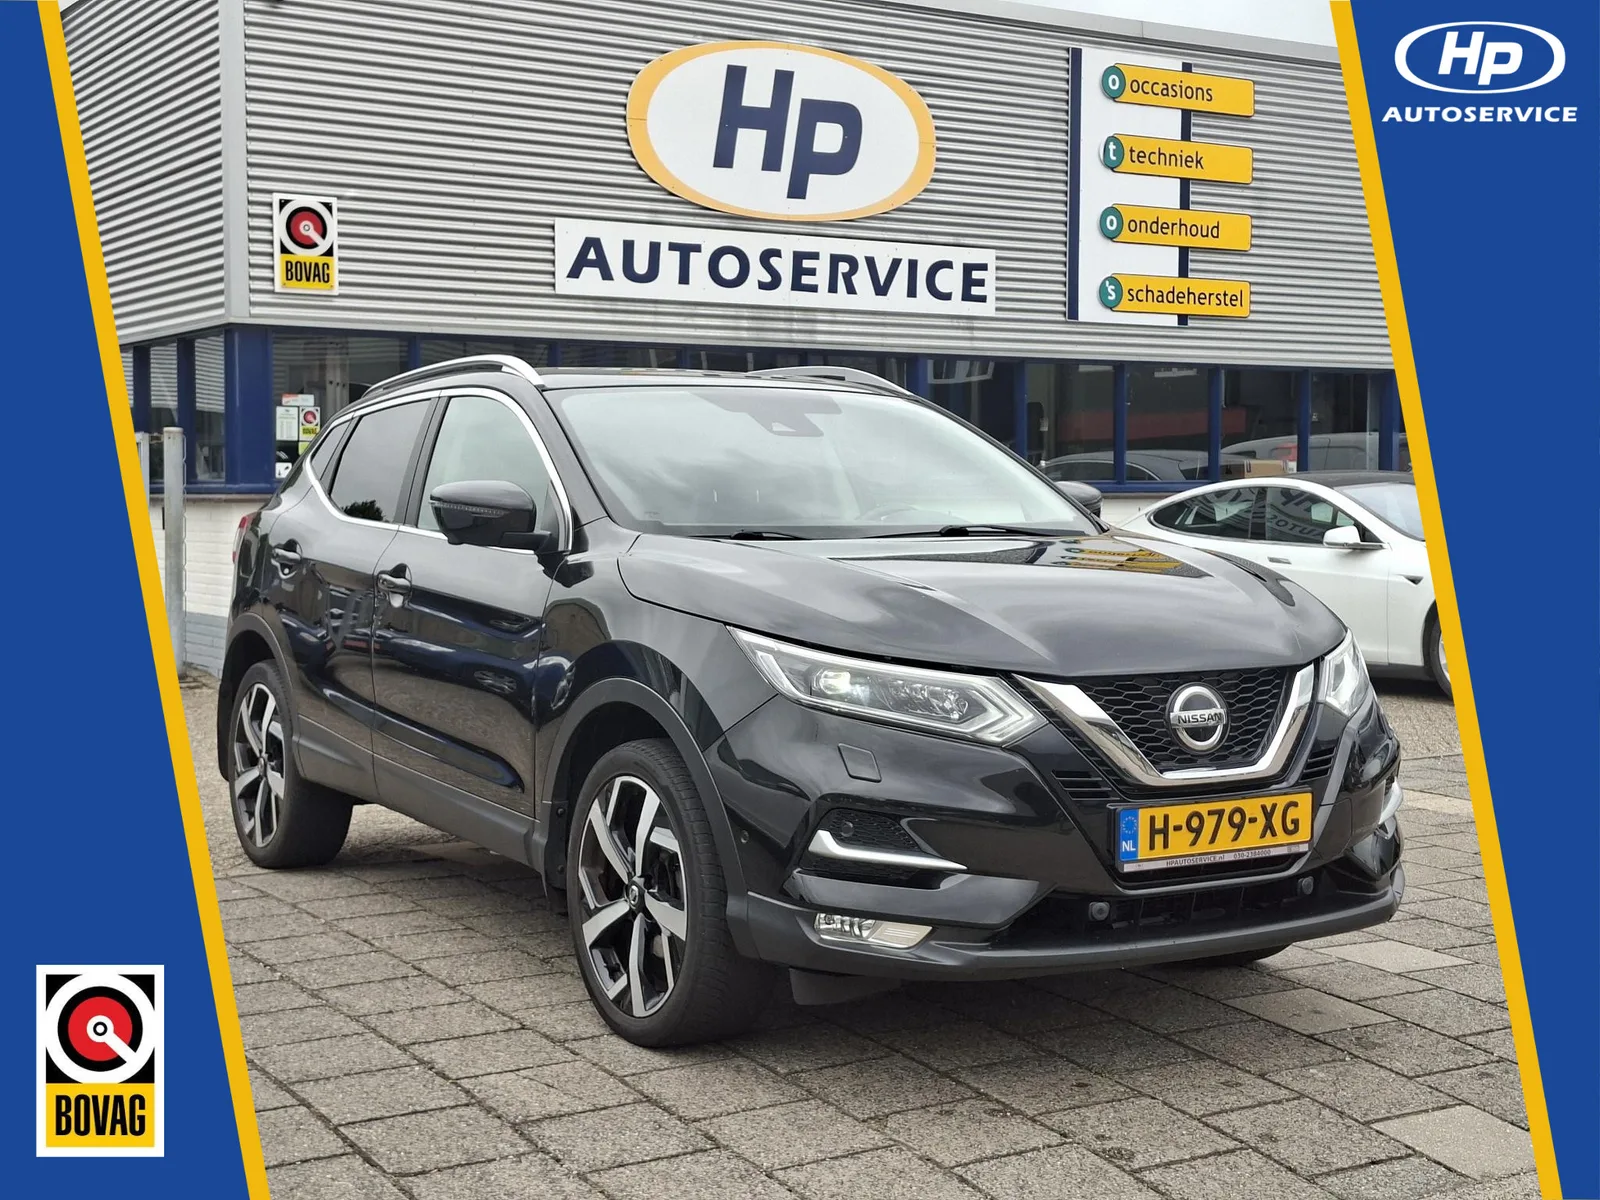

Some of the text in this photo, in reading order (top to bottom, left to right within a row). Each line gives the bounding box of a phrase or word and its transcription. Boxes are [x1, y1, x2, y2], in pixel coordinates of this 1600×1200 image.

[1130, 79, 1213, 102] occasions
[1129, 146, 1204, 170] techniek
[1128, 216, 1220, 239] onderhoud
[285, 260, 330, 283] BOVAG
[566, 236, 989, 303] AUTOSERVICE
[1127, 284, 1243, 307] schadeherstel
[1177, 712, 1222, 724] NISSAN
[1122, 801, 1300, 852] NL H-979-XG
